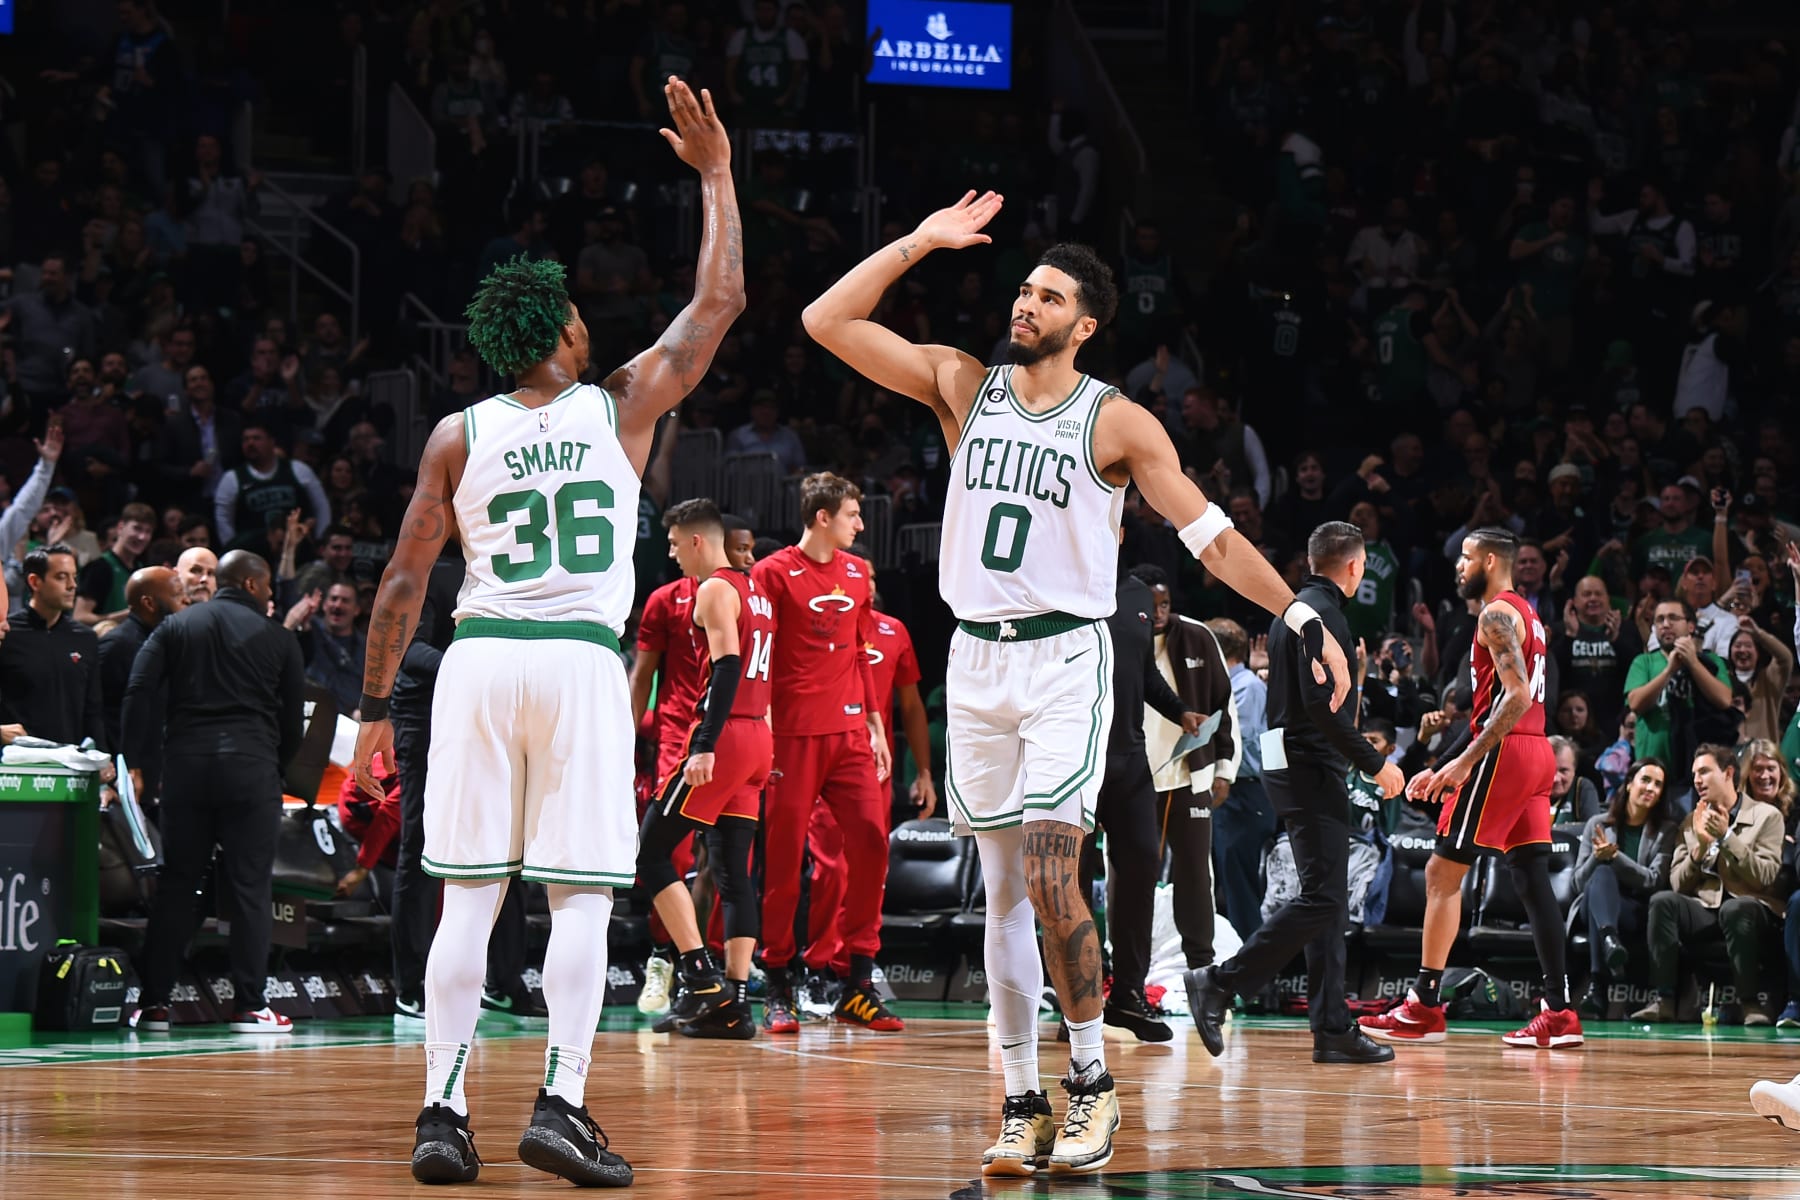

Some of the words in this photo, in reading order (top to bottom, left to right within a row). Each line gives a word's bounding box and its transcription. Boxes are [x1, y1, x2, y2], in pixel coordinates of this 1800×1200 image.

[873, 38, 1002, 63] ARBELLA
[890, 60, 985, 76] INSURANCE
[1138, 292, 1155, 314] 0
[1378, 334, 1394, 365] 0
[1054, 430, 1079, 440] PRINT
[1057, 419, 1081, 431] VISTA
[503, 441, 591, 481] SMART
[965, 437, 1077, 509] CELTICS
[486, 479, 615, 583] 36
[980, 501, 1032, 573] 0
[1357, 578, 1377, 606] 6
[745, 629, 773, 682] 14
